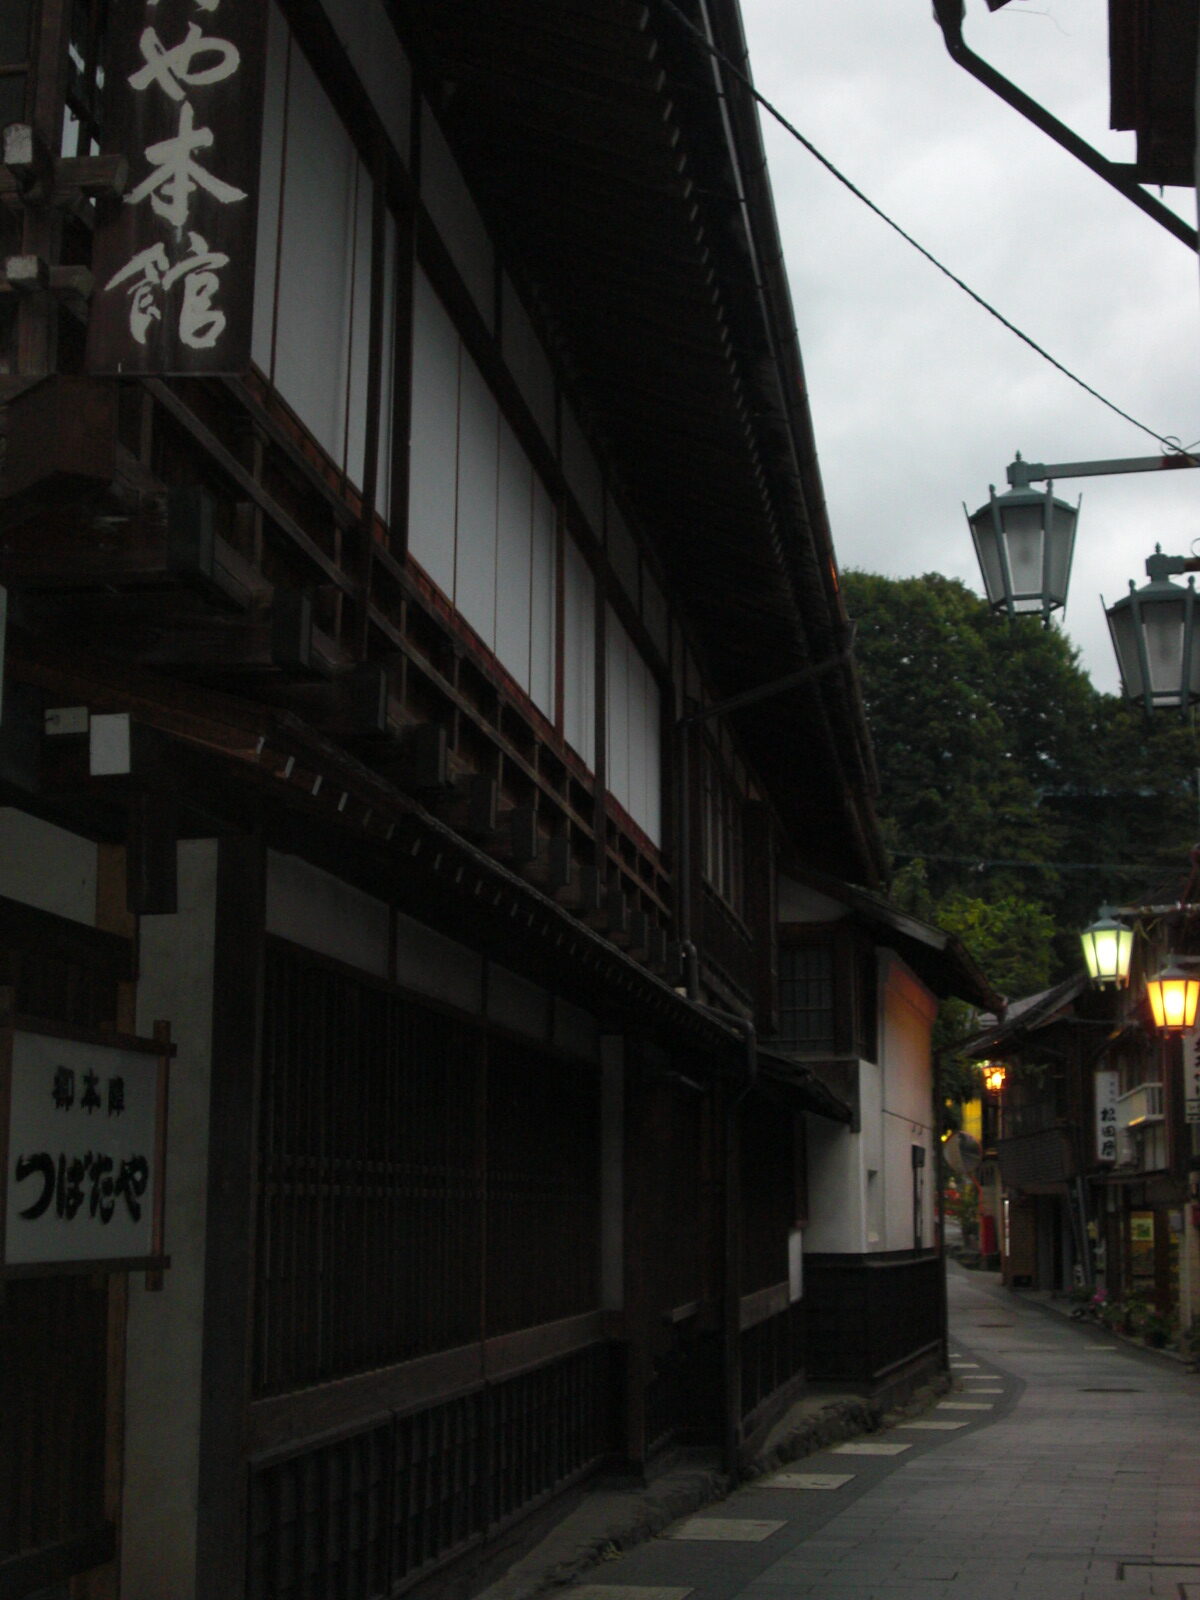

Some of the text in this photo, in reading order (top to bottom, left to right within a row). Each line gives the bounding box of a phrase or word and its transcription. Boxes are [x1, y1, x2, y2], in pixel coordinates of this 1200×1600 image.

[104, 0, 248, 349] や本館
[16, 1151, 148, 1224] つばたや
